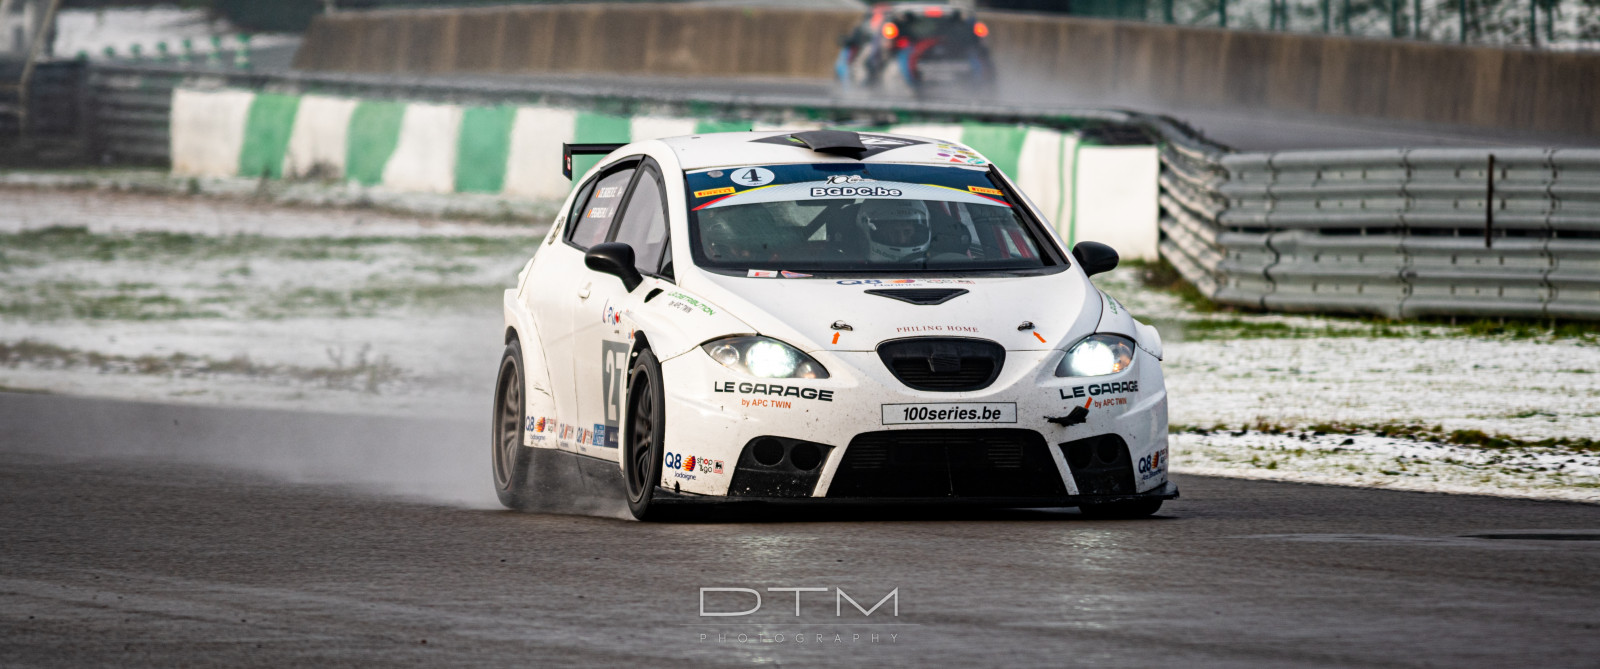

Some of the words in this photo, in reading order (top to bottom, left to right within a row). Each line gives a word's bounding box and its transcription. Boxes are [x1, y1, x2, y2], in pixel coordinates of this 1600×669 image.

[742, 169, 762, 182] 4
[697, 188, 732, 196] PIRELLI
[811, 187, 903, 197] BGDC.be
[896, 325, 943, 333] PHILING
[947, 325, 980, 333] HOME
[606, 350, 626, 421] 27
[714, 381, 736, 393] LE
[738, 382, 834, 402] GARAGE
[1059, 386, 1086, 400] LE
[1088, 380, 1139, 396] GARAGE
[741, 398, 750, 407] by
[752, 398, 768, 408] APC
[771, 400, 792, 409] TWIN
[1094, 400, 1102, 409] by
[1115, 397, 1127, 405] TWIN
[903, 406, 1001, 421] 100series.be
[526, 416, 535, 432] Q8
[665, 452, 682, 470] Q8
[697, 456, 713, 466] shop
[1138, 454, 1152, 474] Q8
